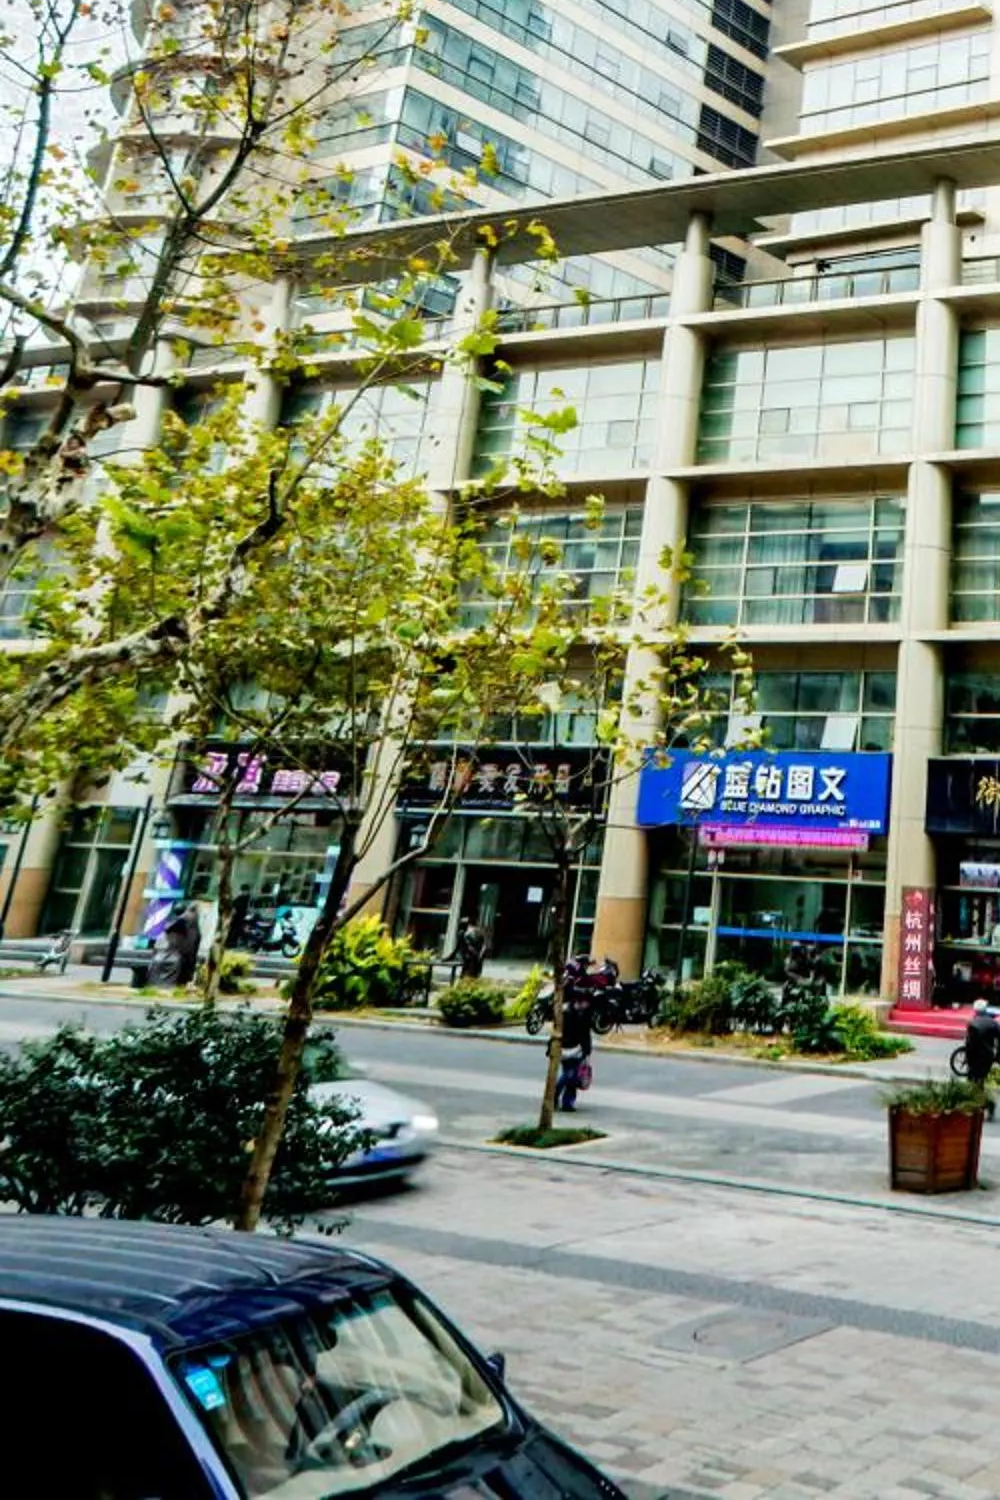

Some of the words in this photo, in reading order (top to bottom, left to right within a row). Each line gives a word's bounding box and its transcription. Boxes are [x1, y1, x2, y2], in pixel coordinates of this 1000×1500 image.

[723, 763, 846, 801] 蓝钻图文
[748, 802, 798, 815] DIAMOND
[799, 803, 847, 817] GRAPHIC
[902, 909, 923, 1001] 杭州丝绸
